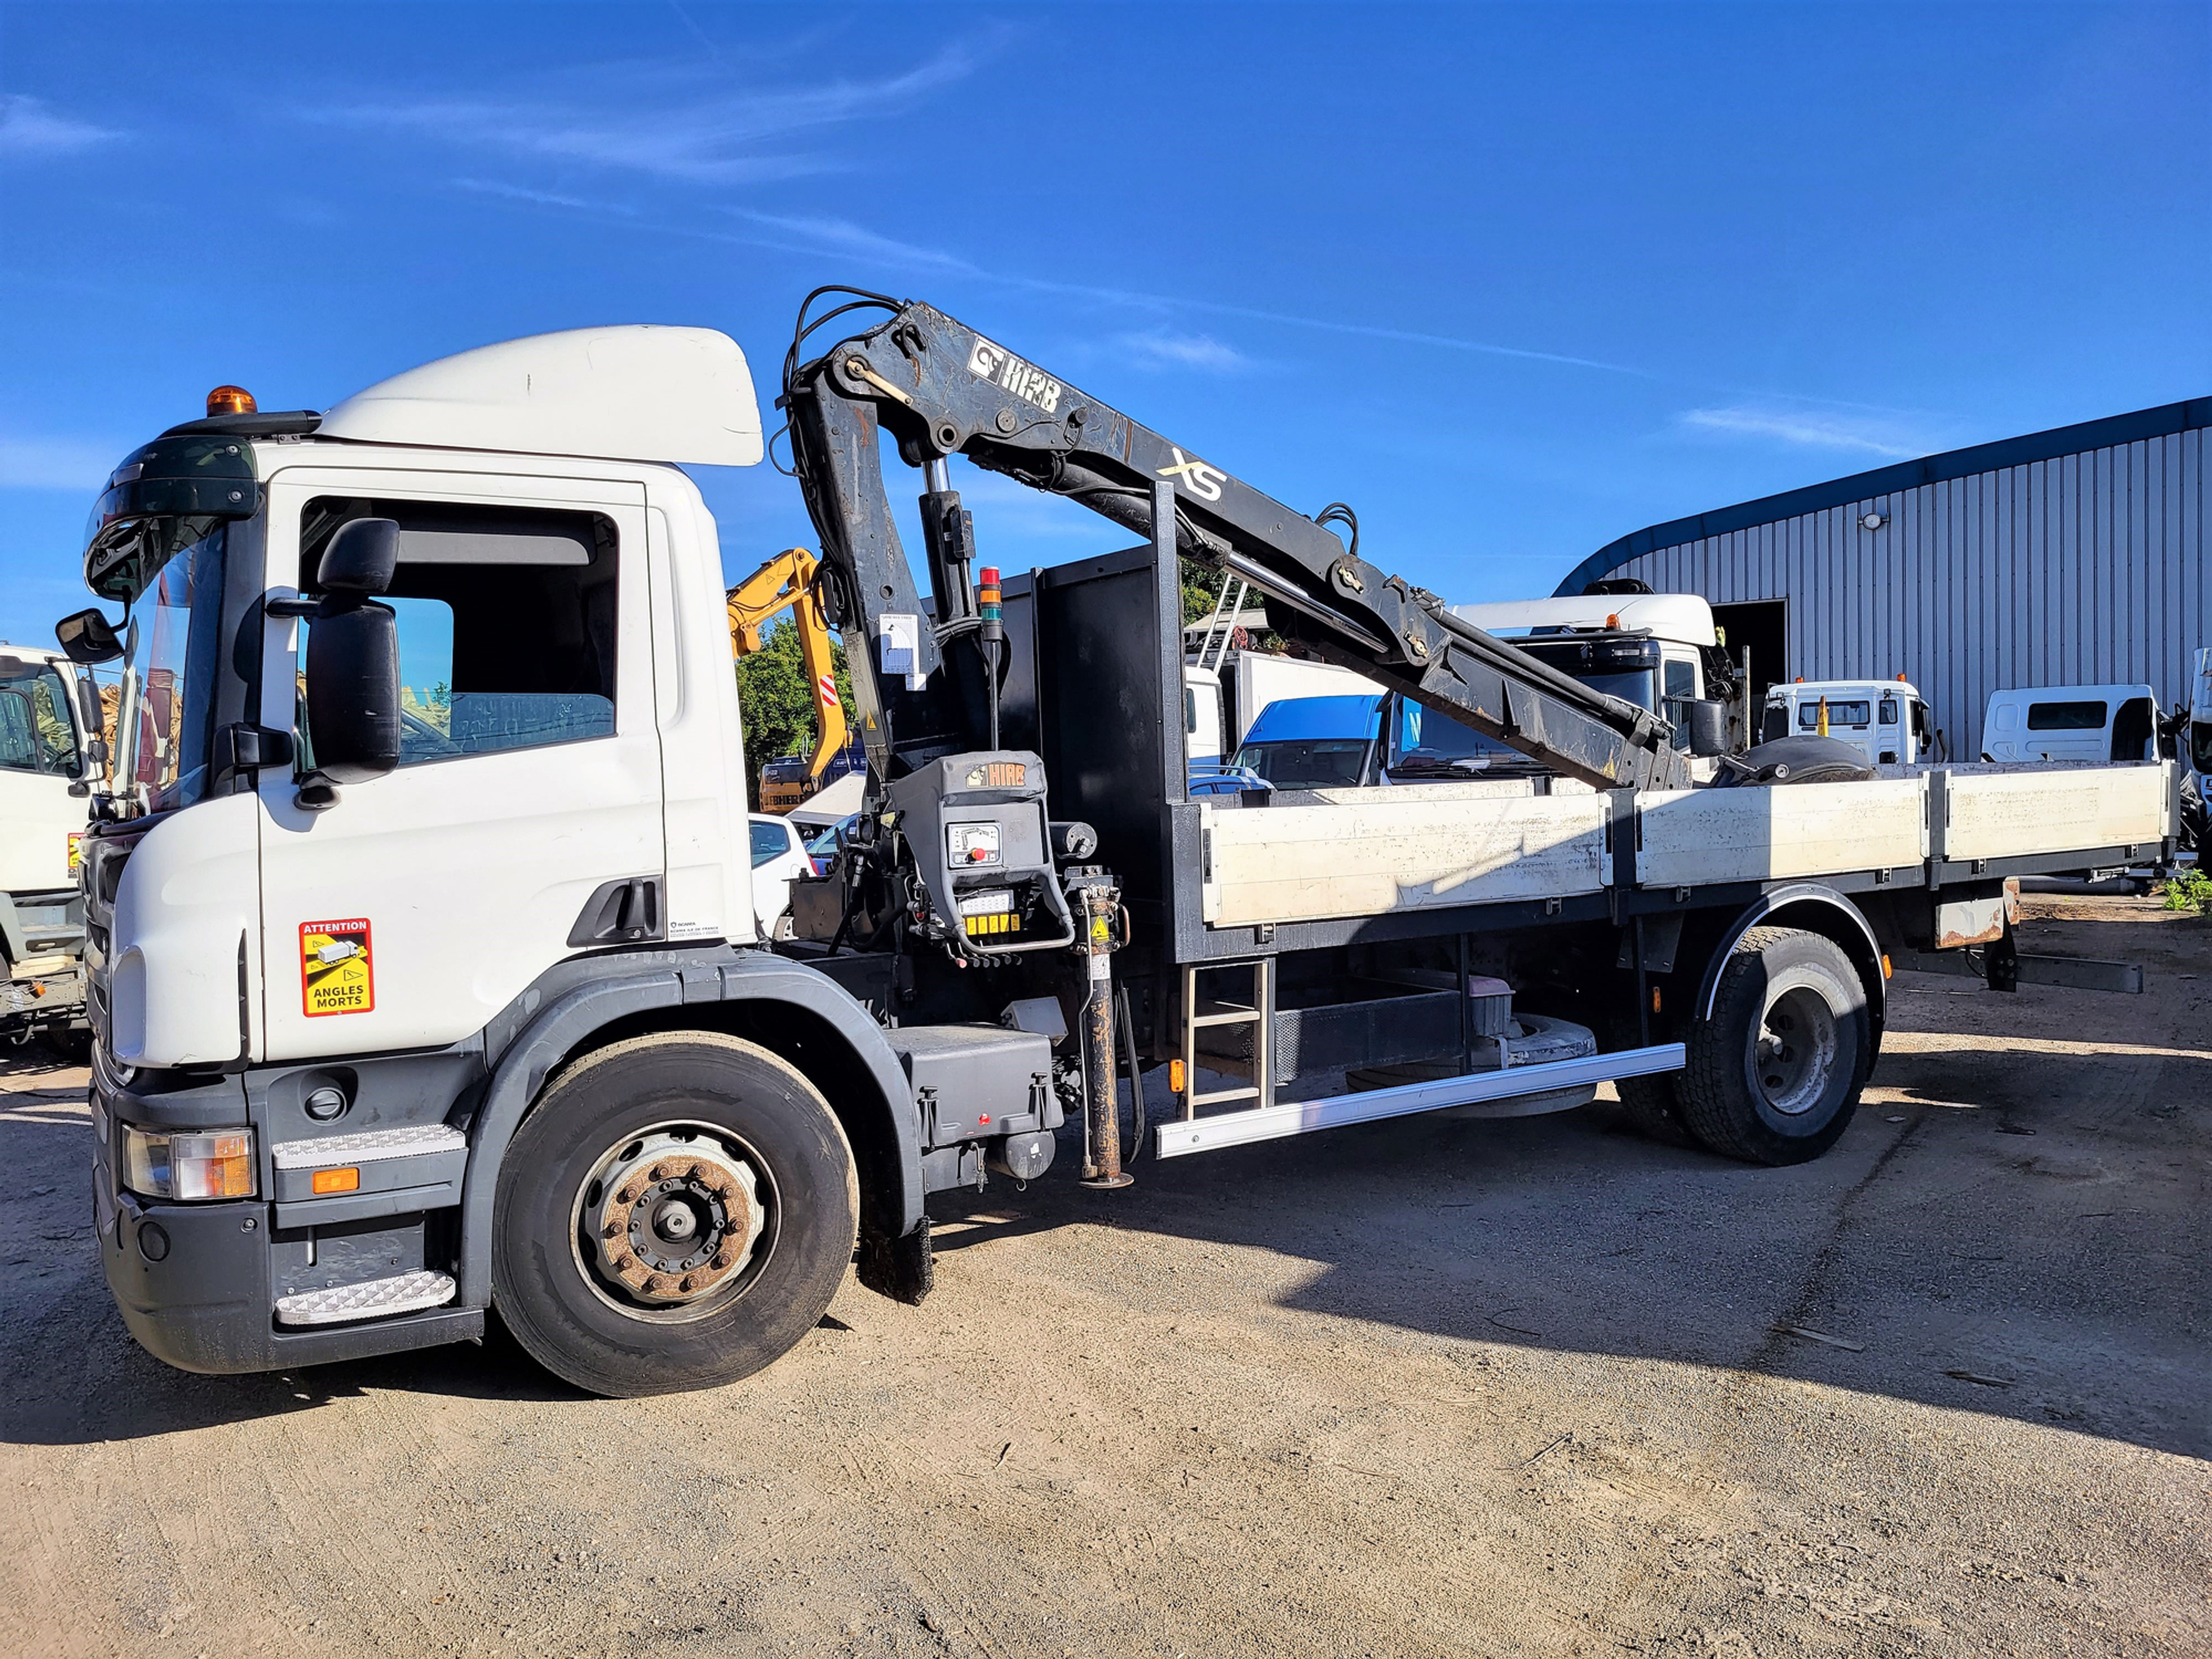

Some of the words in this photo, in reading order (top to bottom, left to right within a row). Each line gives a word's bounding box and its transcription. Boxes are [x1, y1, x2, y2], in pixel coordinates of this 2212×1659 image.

[1156, 447, 1227, 502] XS
[989, 763, 1026, 786] HIAB
[304, 921, 367, 933] ATTENTION
[314, 985, 363, 998] ANGLES
[317, 995, 362, 1008] MORTS
